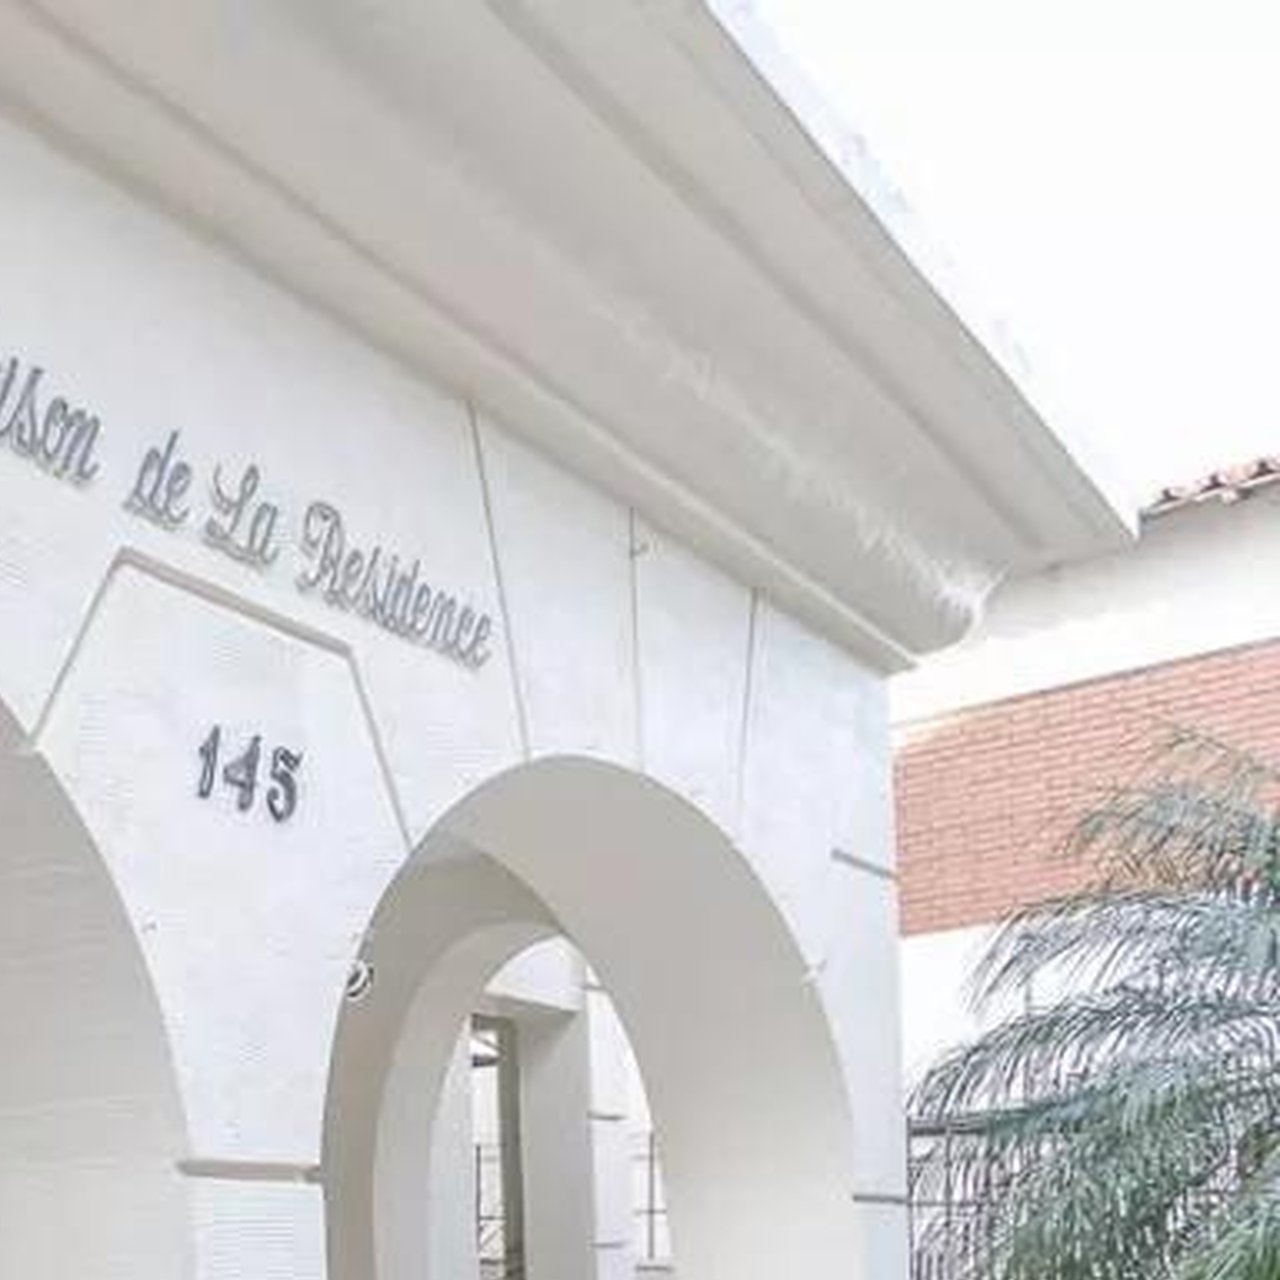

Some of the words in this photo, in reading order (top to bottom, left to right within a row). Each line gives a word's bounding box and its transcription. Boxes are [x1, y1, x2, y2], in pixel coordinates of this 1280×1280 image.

[124, 431, 191, 526] de
[205, 463, 280, 567] La
[297, 501, 492, 667] Residence
[196, 725, 303, 822] 145
